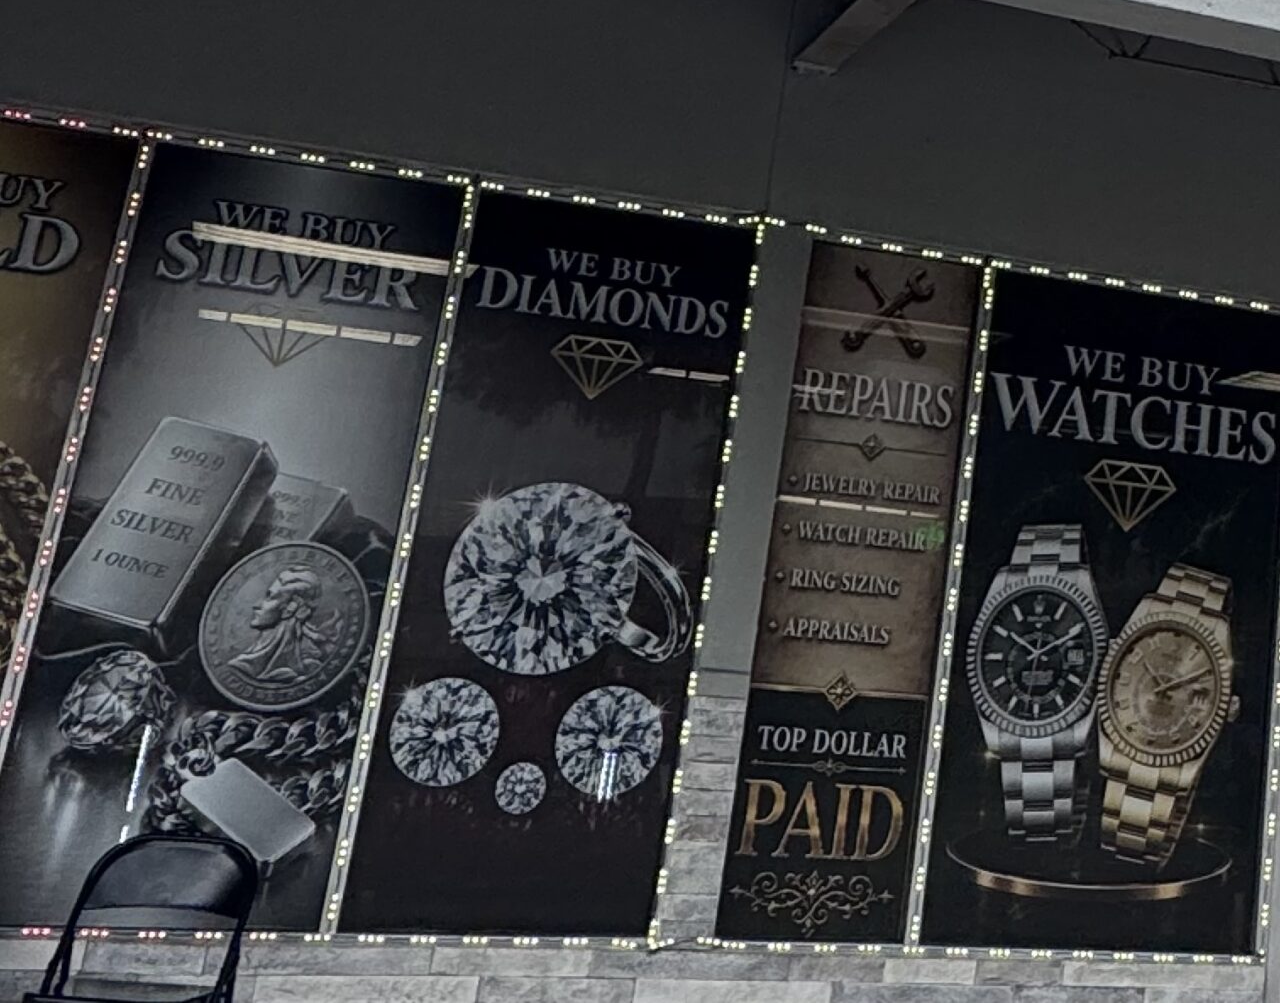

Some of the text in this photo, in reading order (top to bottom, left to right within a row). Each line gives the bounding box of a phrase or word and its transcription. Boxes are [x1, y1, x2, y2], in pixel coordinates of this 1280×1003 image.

[0, 173, 63, 209] UY
[216, 200, 395, 250] WE BUY
[155, 229, 419, 311] SILVER
[547, 248, 682, 288] WE BUY
[474, 264, 730, 339] DIAMONDS
[1064, 345, 1220, 396] WE BUY
[798, 368, 954, 428] REPAIRS
[990, 371, 1277, 465] WATCHES
[168, 446, 225, 471] 999.9
[146, 478, 205, 505] FINE
[803, 472, 940, 503] JEWELRY REPAIR
[110, 509, 194, 543] SILVER
[799, 521, 860, 544] WATCH
[104, 552, 169, 578] OUNCE
[790, 568, 900, 596] RING SIZING
[783, 617, 890, 644] APPRAISALS
[758, 725, 907, 759] TOP DOLLAR
[734, 778, 904, 861] PAID
